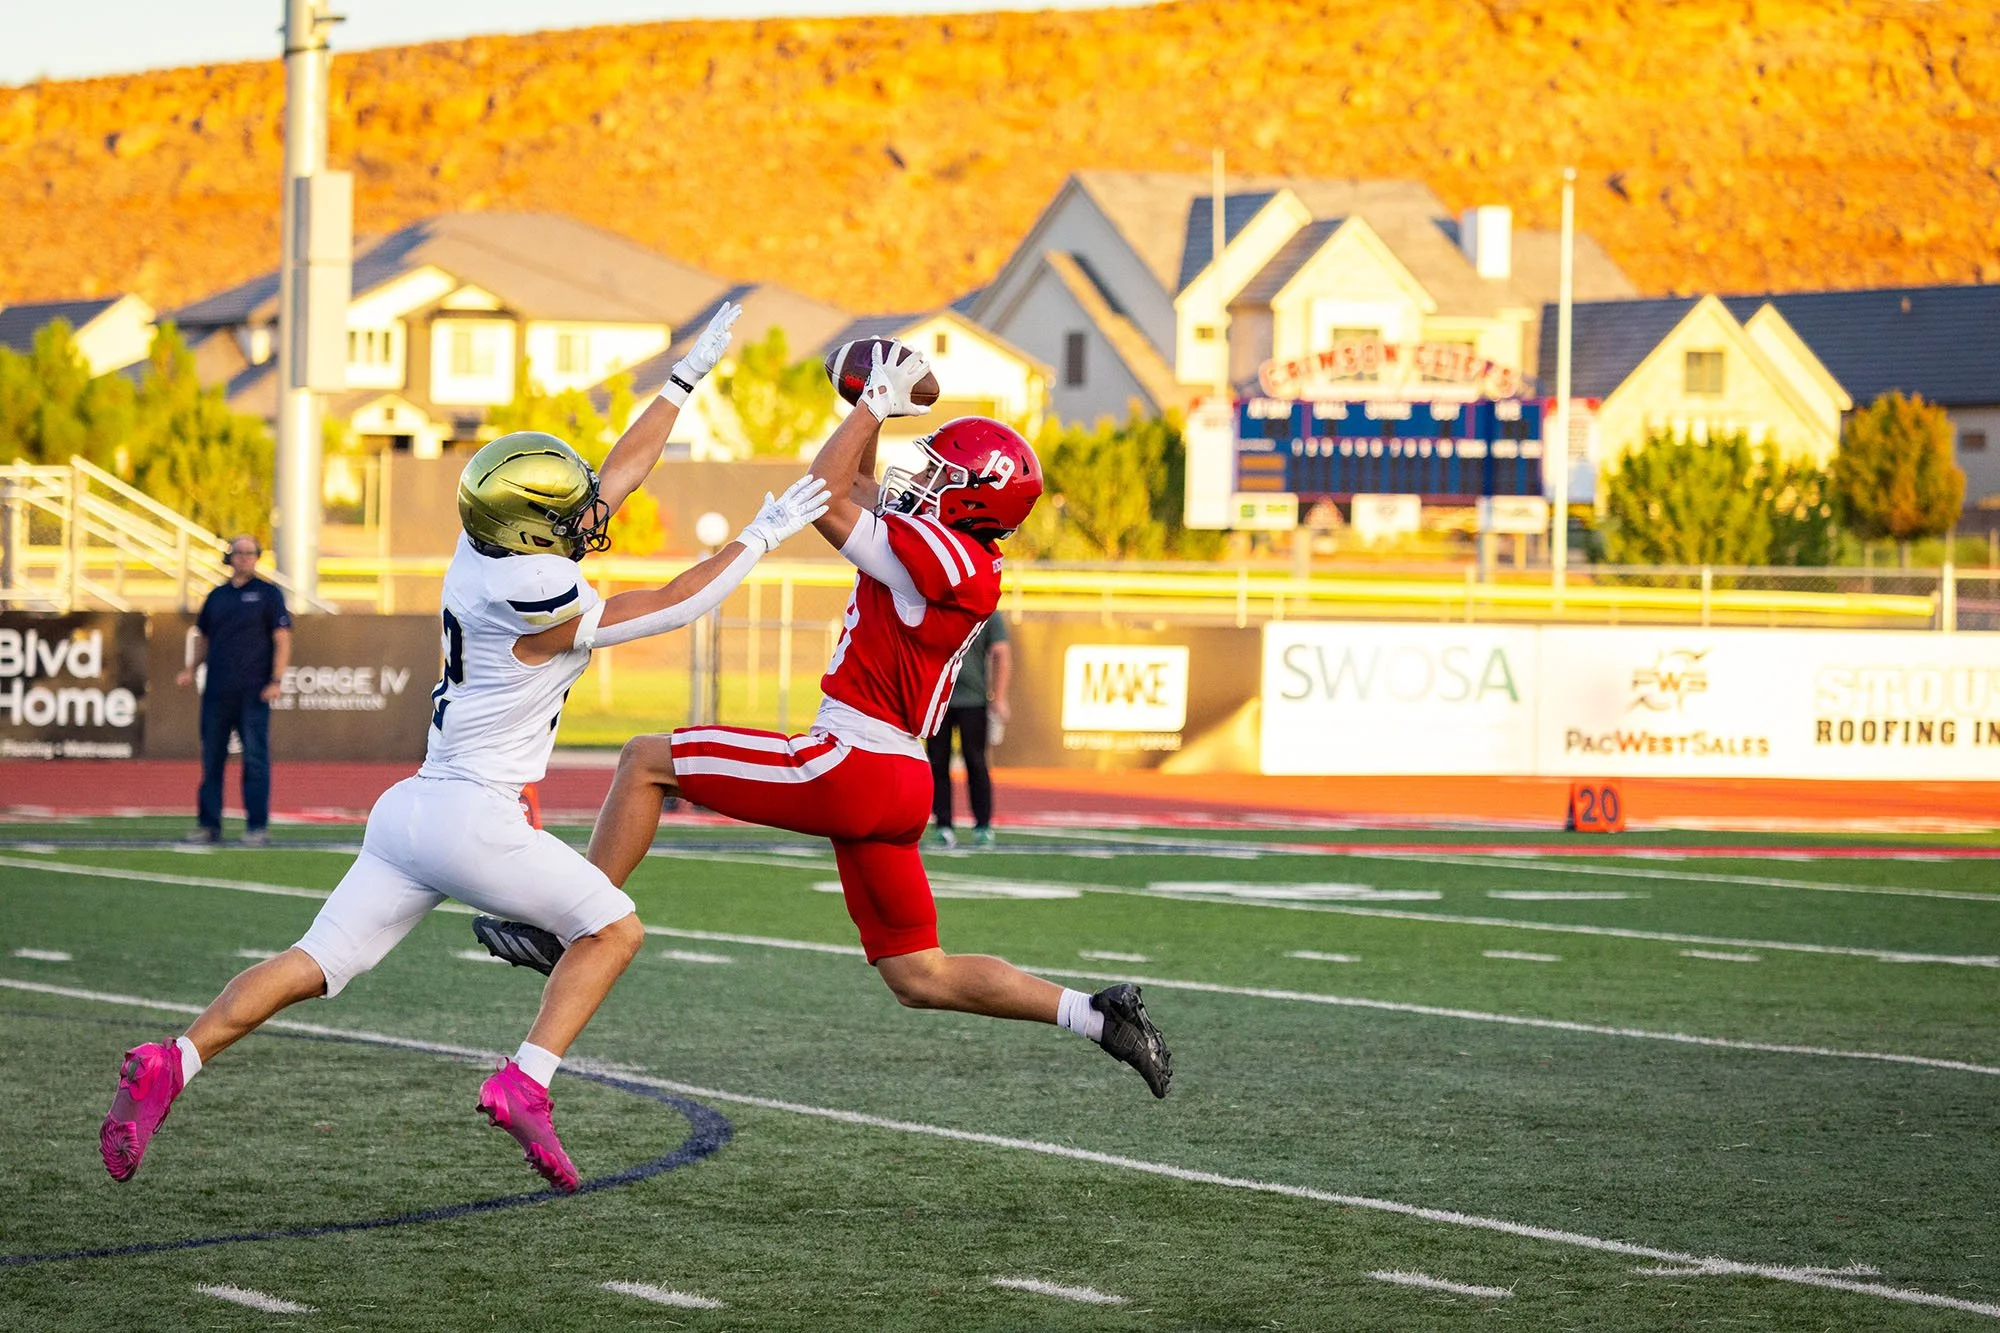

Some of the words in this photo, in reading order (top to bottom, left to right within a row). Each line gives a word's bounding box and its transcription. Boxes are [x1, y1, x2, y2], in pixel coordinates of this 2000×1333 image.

[981, 449, 1015, 490] 19
[0, 628, 103, 678] Blvd
[1281, 644, 1518, 702] SWOSA
[280, 666, 374, 694] EORGE
[1082, 662, 1169, 706] MAKE
[1814, 662, 2000, 716] STOU
[0, 677, 138, 728] Home
[1816, 719, 1955, 744] ROOFING
[1579, 788, 1619, 823] 20
